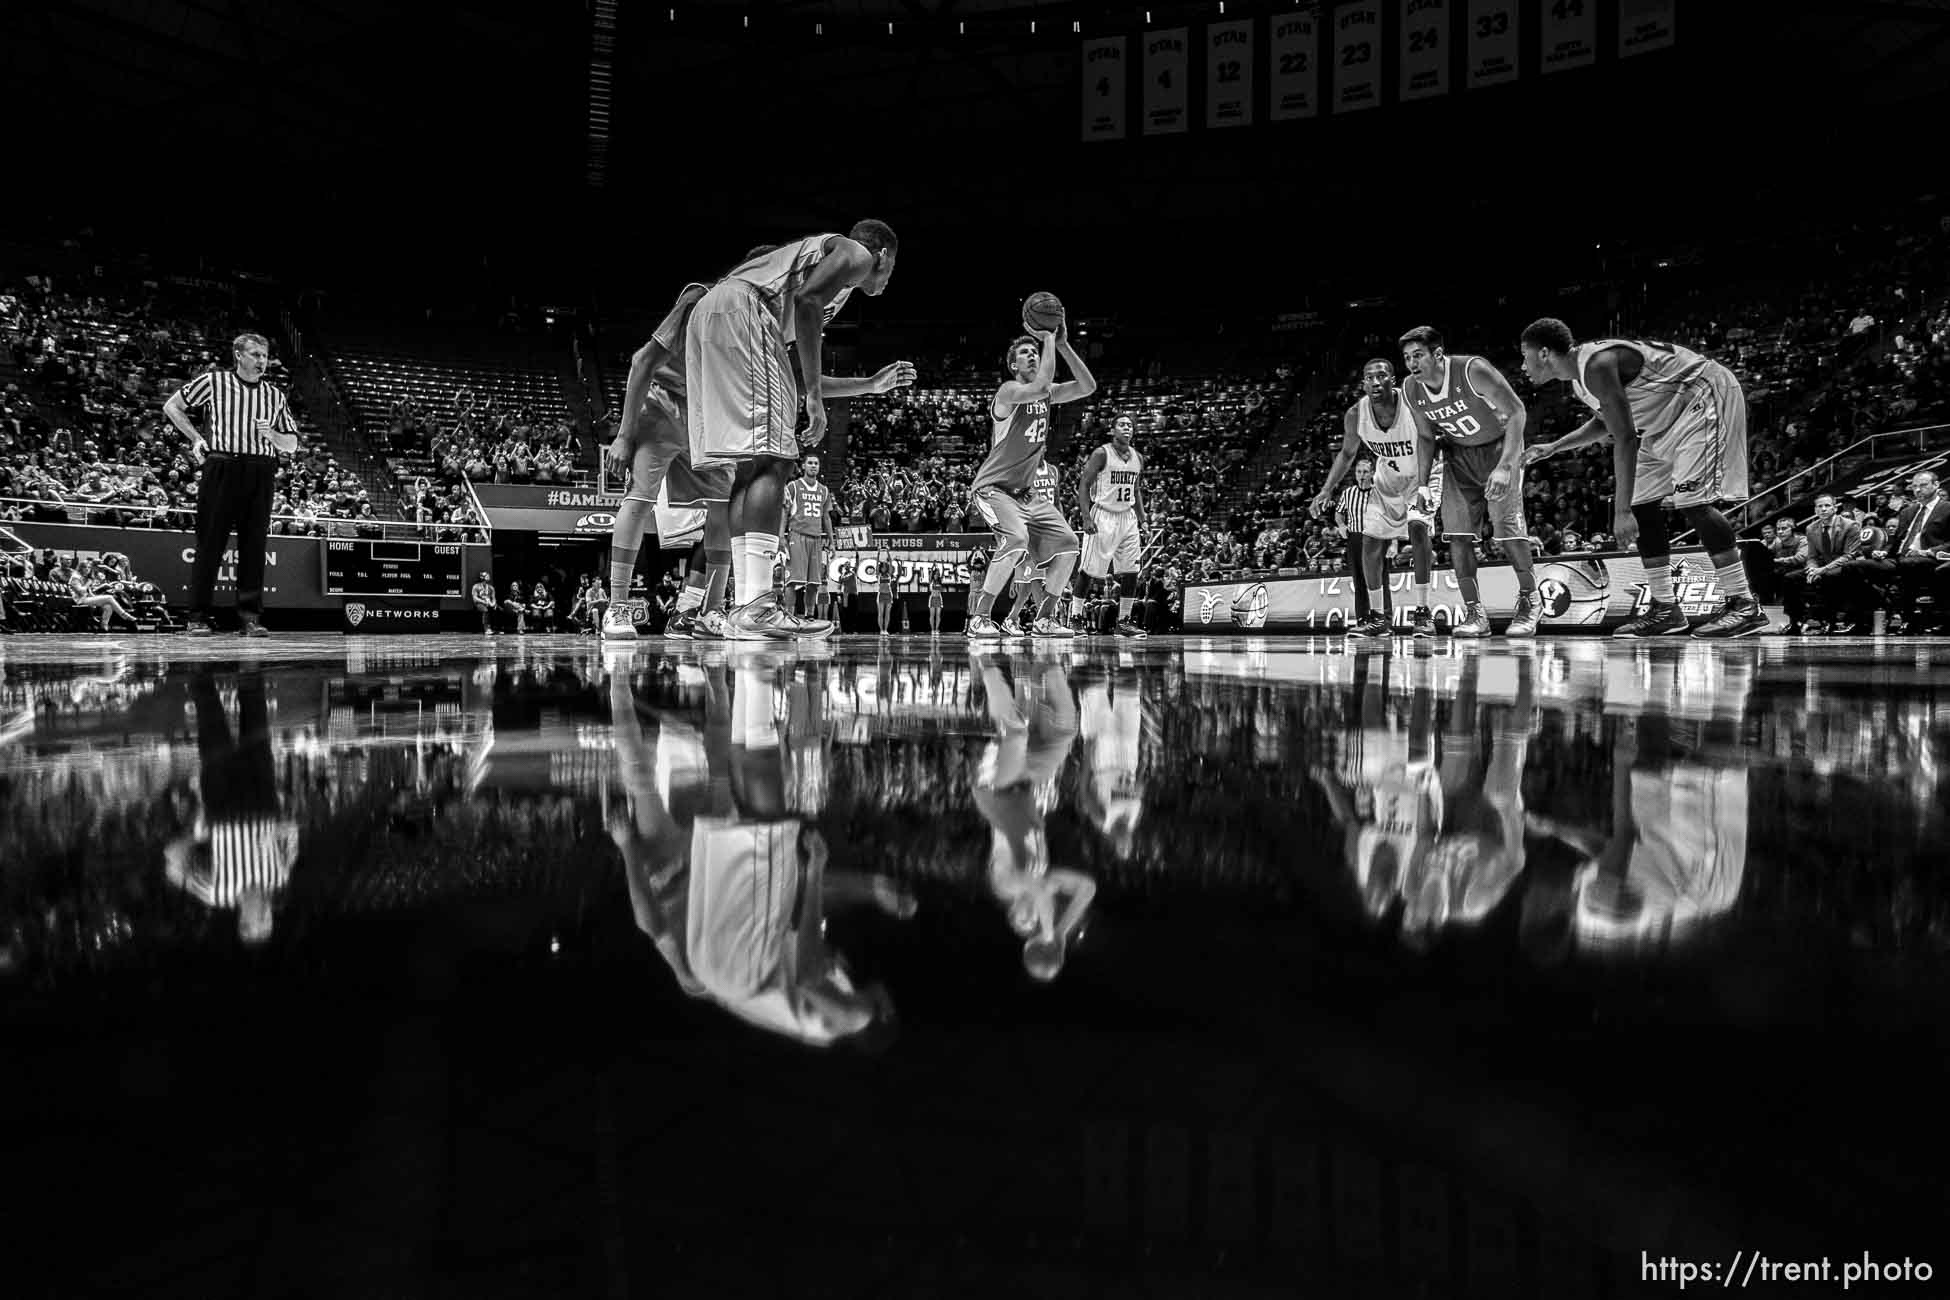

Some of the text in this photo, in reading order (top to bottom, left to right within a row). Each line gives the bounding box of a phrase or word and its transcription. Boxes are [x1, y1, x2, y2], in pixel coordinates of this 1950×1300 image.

[1277, 23, 1312, 39] UTAH
[1476, 12, 1508, 38] 33
[1149, 40, 1183, 56] UTAH
[1213, 32, 1247, 48] UTAH
[1407, 27, 1438, 53] 24
[1088, 47, 1121, 63] UTAH
[1340, 42, 1371, 66] 23
[1280, 53, 1308, 75] 22
[1158, 68, 1172, 90] 4
[1216, 61, 1242, 84] 12
[1096, 76, 1111, 98] 4
[1425, 399, 1469, 420] UTAH
[1024, 418, 1047, 443] 42
[1438, 414, 1481, 438] 20
[1368, 440, 1414, 457] HORNETS
[802, 493, 822, 501] UTAH
[1116, 488, 1131, 502] 12
[804, 502, 821, 517] 25
[329, 542, 354, 551] HOME
[434, 546, 460, 555] GUEST
[892, 538, 923, 548] MUSS
[366, 609, 440, 618] NETWORKS
